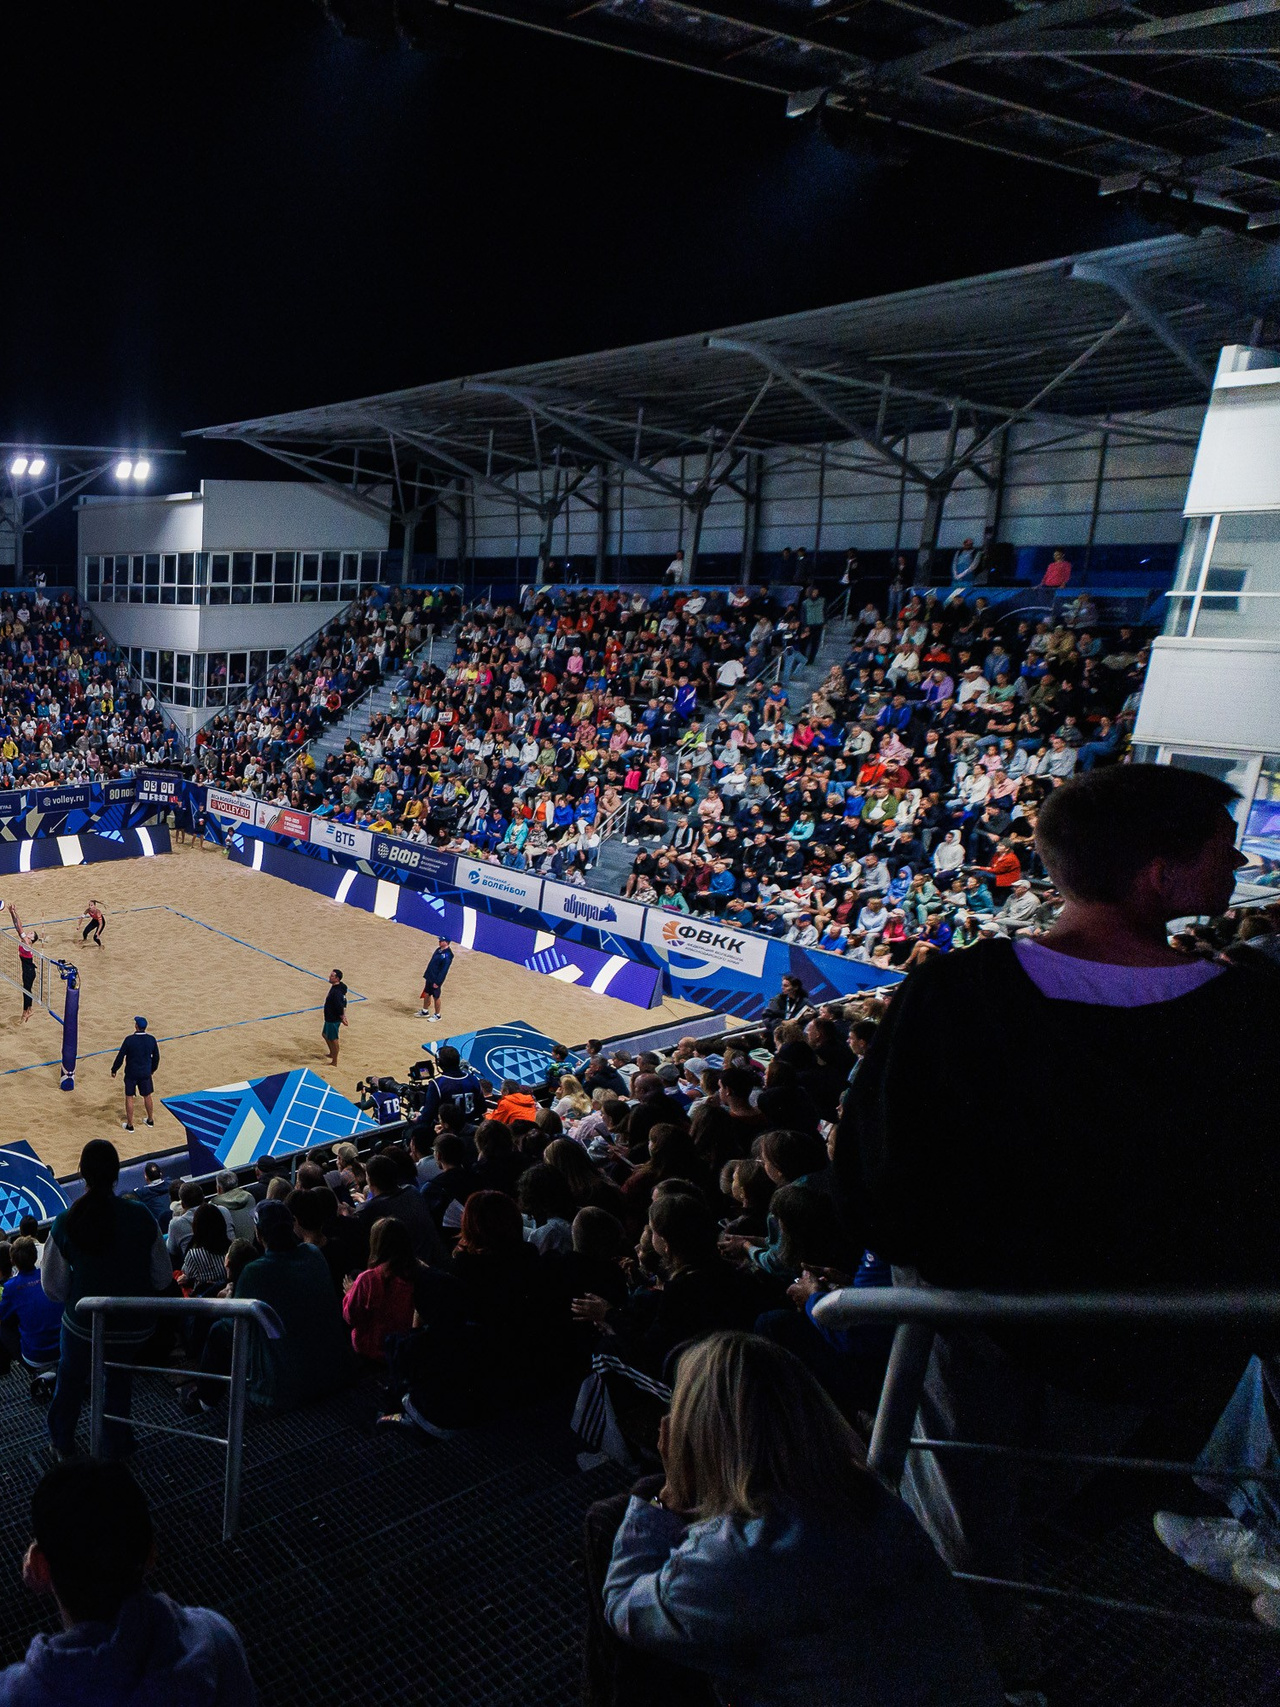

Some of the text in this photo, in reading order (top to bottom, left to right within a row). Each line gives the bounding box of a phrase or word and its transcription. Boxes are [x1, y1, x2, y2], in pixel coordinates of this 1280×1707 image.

[52, 795, 84, 805] volley.ru
[109, 788, 120, 800] 80
[217, 801, 250, 818] VOLLEY.RU
[335, 830, 356, 847] ВТБ
[388, 846, 421, 868] ВФВ
[482, 880, 527, 897] ВОЛЕЙБОЛ
[678, 925, 746, 954] ФВКК
